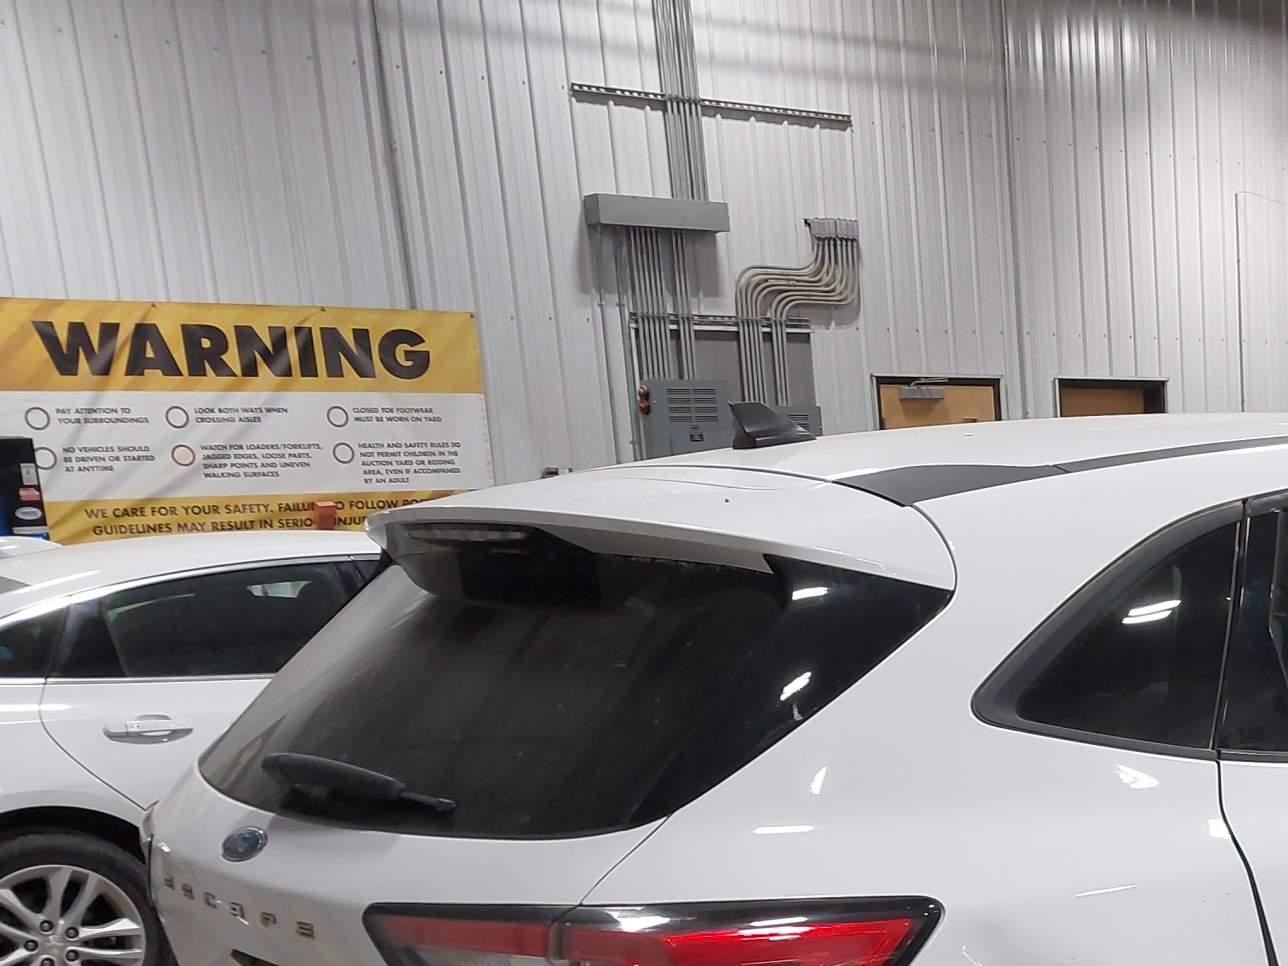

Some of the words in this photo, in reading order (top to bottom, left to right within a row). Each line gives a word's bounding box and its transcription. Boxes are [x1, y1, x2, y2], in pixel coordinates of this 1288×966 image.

[31, 320, 431, 380] WARNING
[55, 407, 71, 415] PAY
[74, 407, 118, 415] ATTENTION
[120, 407, 131, 415] TO
[57, 417, 81, 425] YOUR
[195, 416, 236, 424] CROSSING
[261, 452, 286, 460] LOOSE
[65, 465, 75, 473] AT
[203, 462, 228, 470] SHARP
[203, 471, 241, 479] WALKING
[243, 470, 280, 478] SURFACES
[364, 477, 373, 485] BY
[84, 508, 108, 519] WE
[112, 506, 147, 518] CARE
[150, 505, 178, 517] FOR
[181, 504, 221, 516] YOUR
[349, 499, 399, 510] FOLLOW
[92, 521, 173, 536] GUIDELINES
[176, 521, 206, 533] MAY
[211, 519, 256, 531] RESULT
[259, 518, 274, 529] IN
